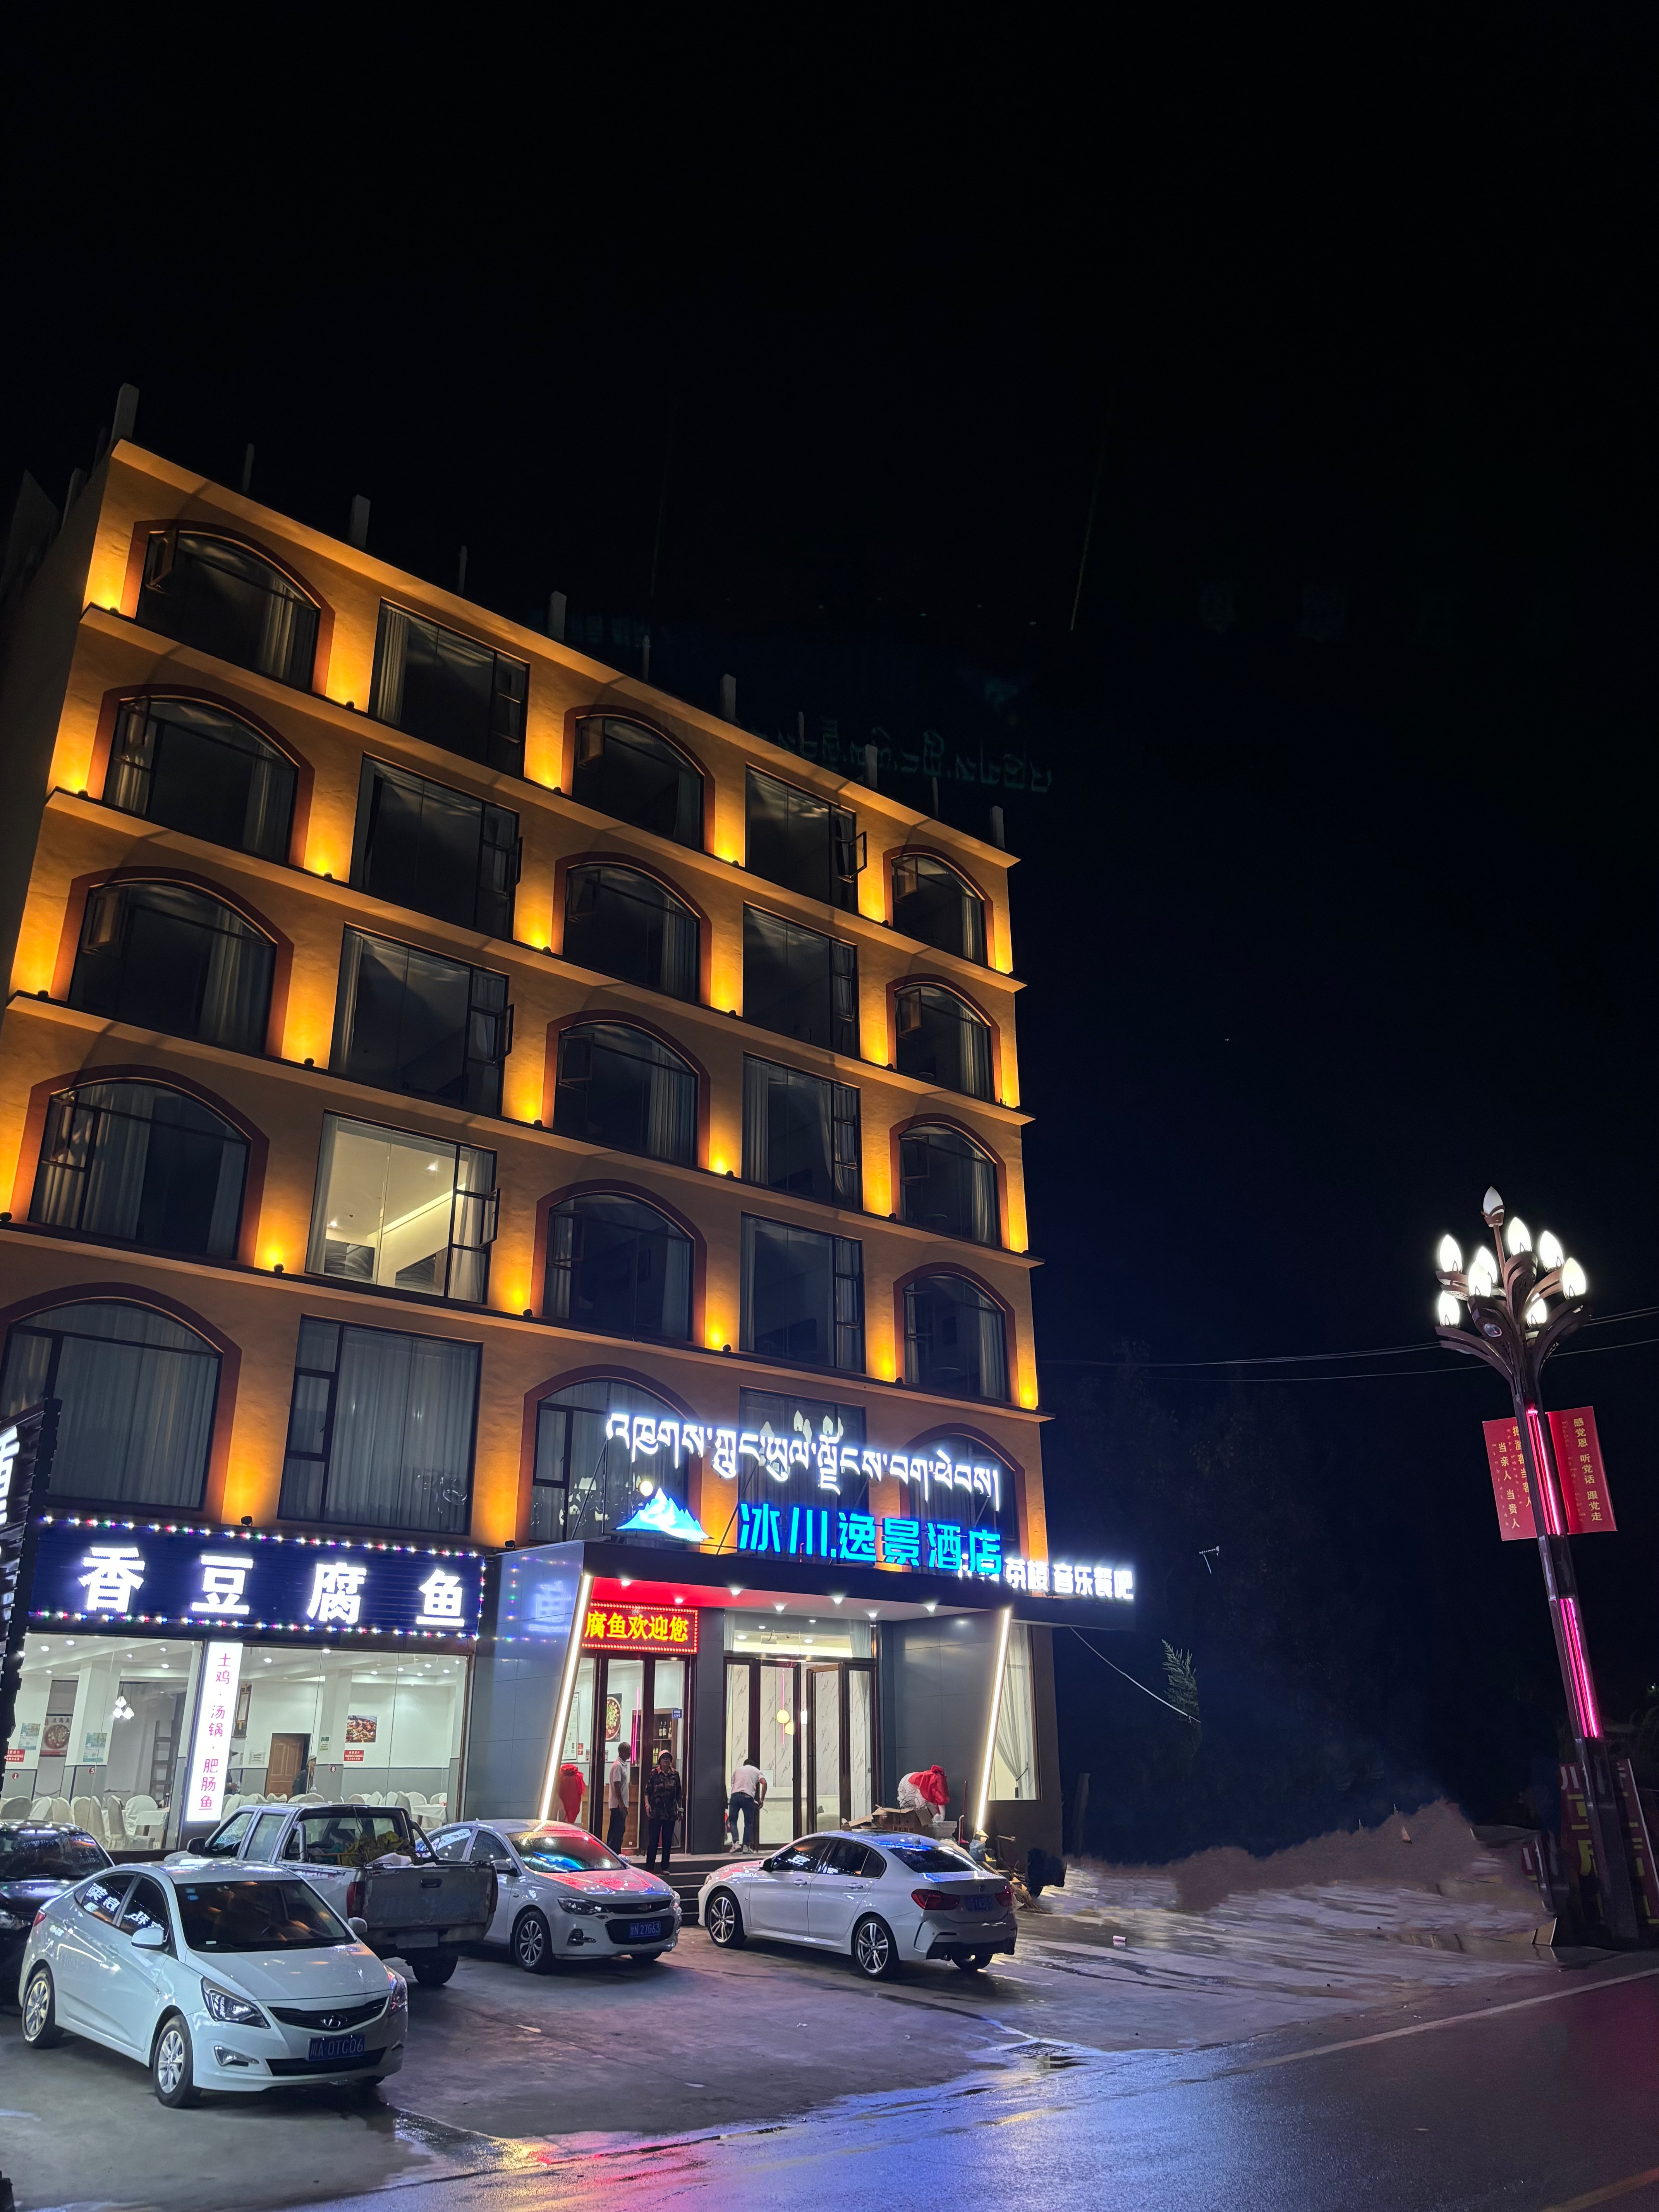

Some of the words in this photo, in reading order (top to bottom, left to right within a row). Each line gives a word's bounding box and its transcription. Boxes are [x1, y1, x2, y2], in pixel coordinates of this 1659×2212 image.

[1574, 1417, 1588, 1448] 感党恩
[1580, 1454, 1595, 1484] 听党话
[1587, 1491, 1602, 1521] 跟党走
[739, 1503, 1002, 1573] 冰川逸景酒店
[78, 1546, 465, 1627] 香豆腐鱼
[1053, 1563, 1134, 1599] 音乐餐吧
[584, 1611, 689, 1642] 腐鱼欢迎您
